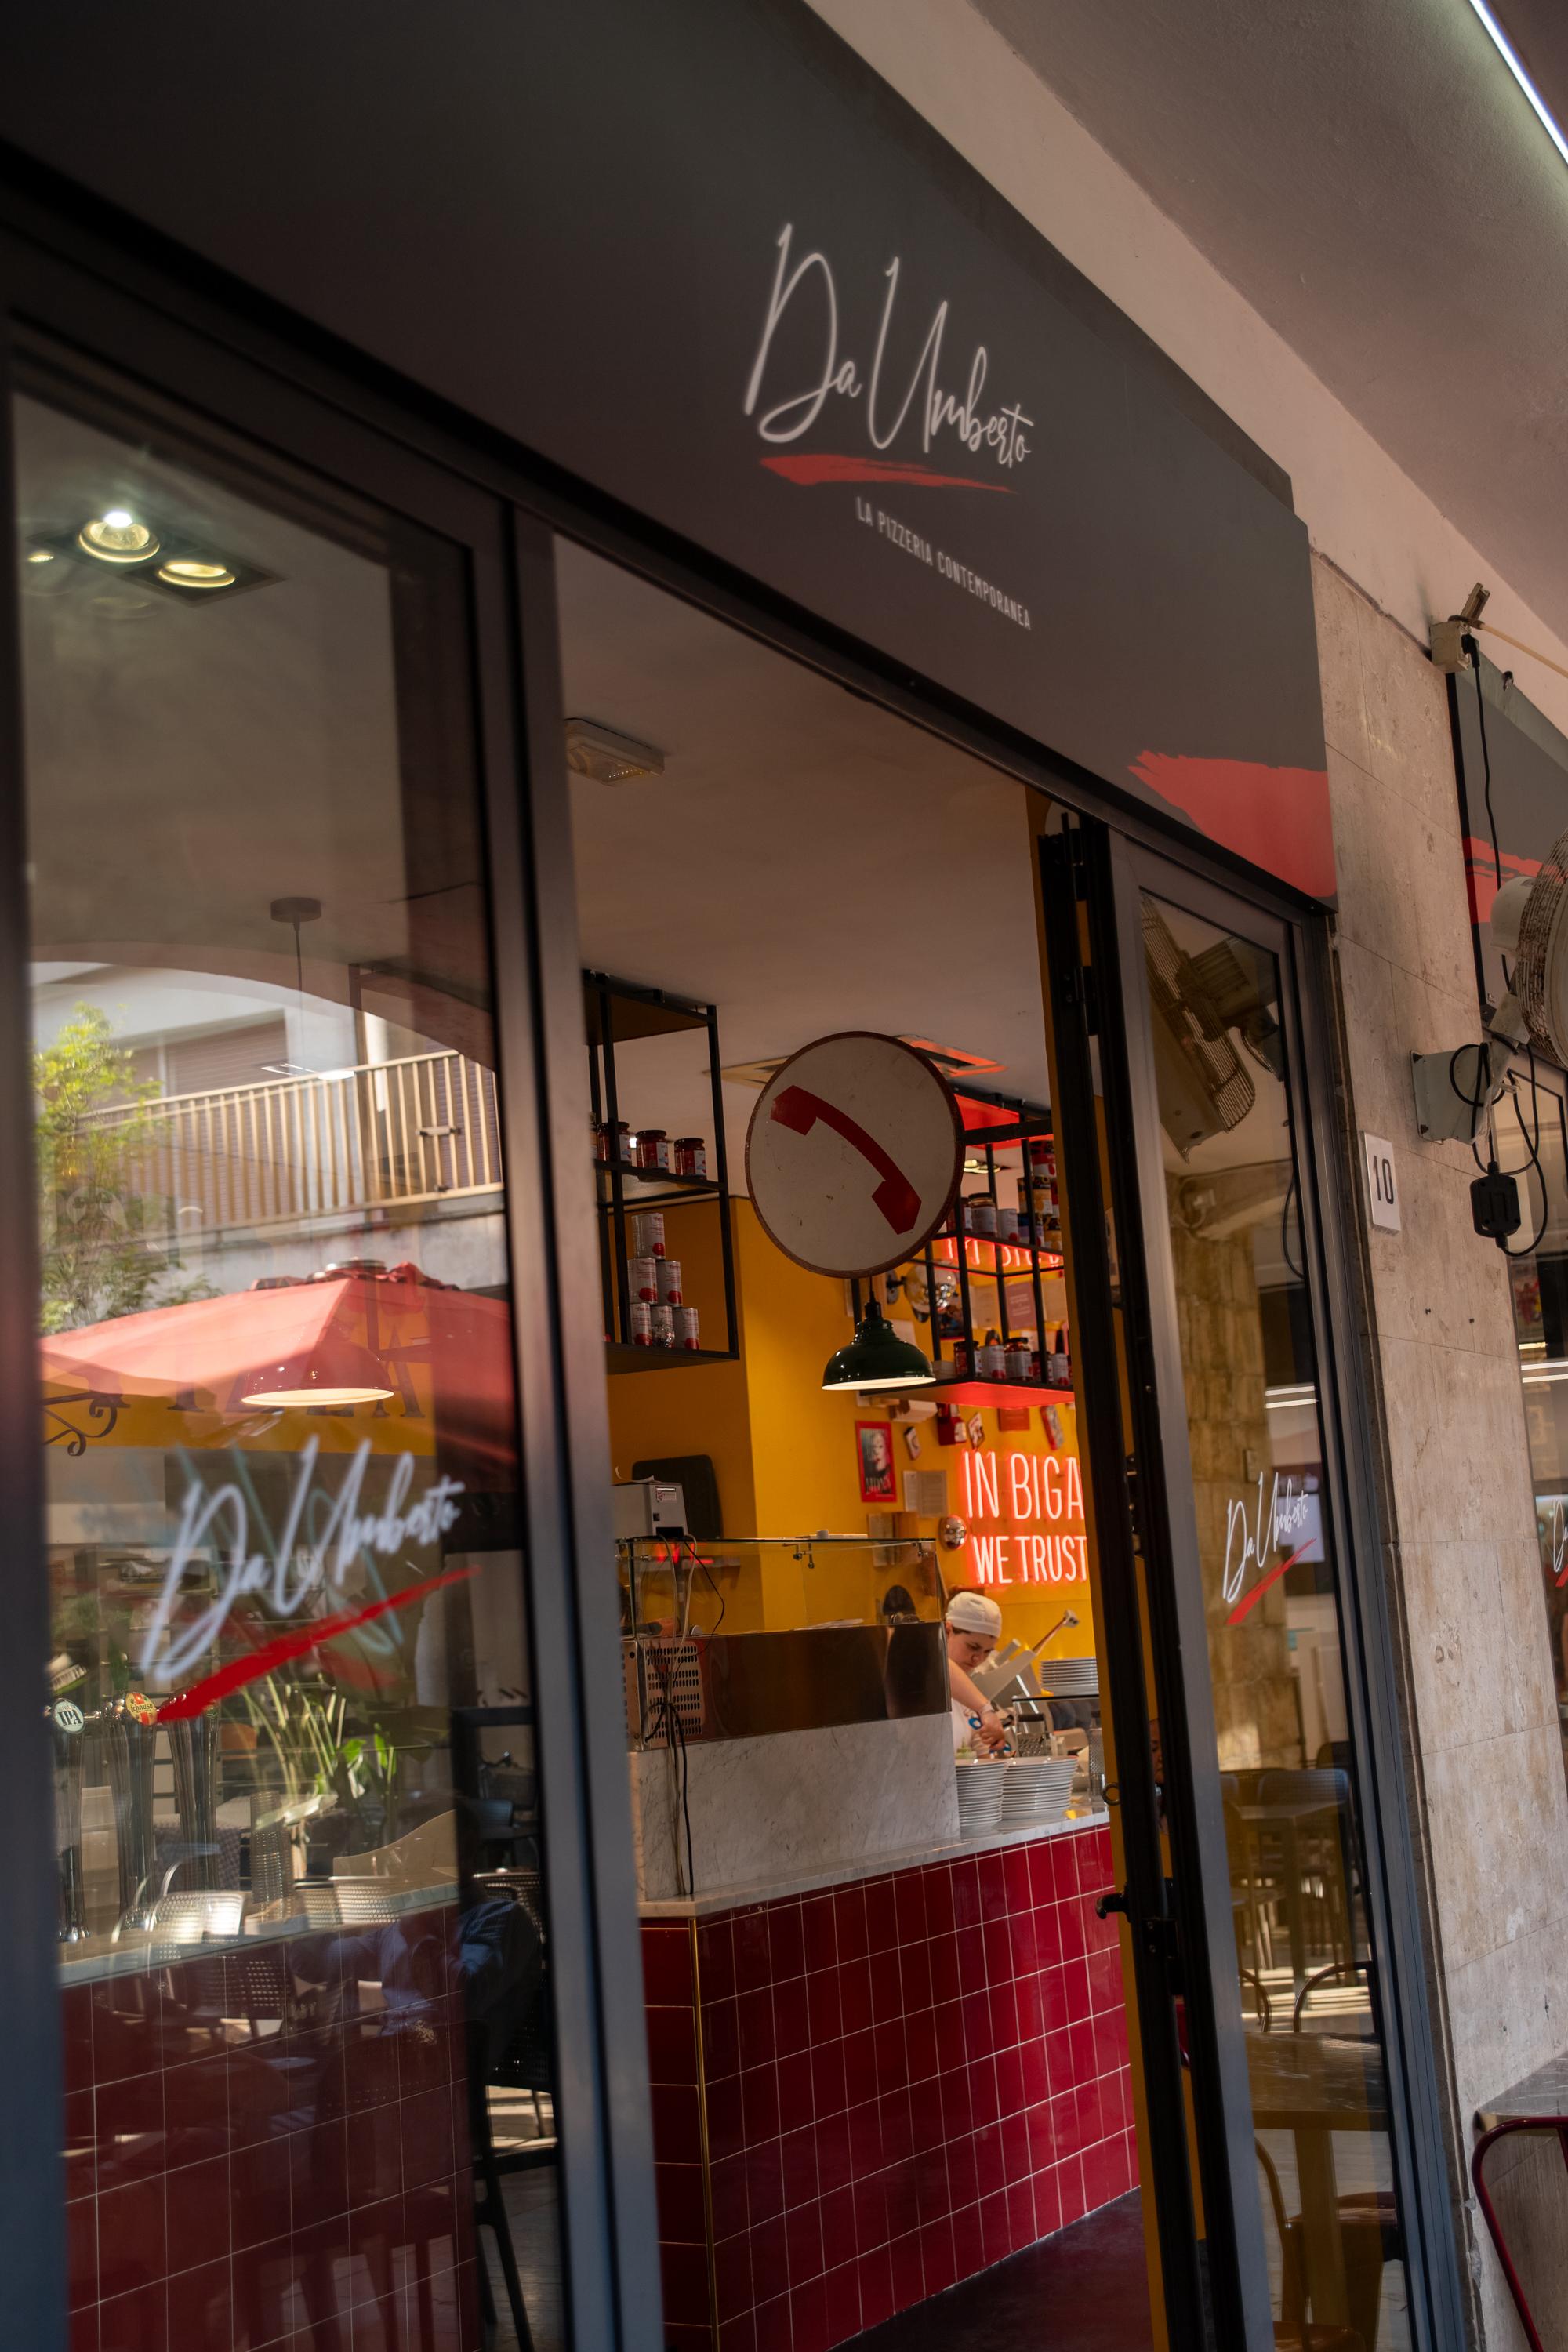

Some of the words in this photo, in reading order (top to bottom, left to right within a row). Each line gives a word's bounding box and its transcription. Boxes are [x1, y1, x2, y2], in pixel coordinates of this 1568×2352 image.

[744, 223, 862, 442] Da
[869, 256, 1034, 468] Umberto
[856, 496, 873, 528] LA
[878, 512, 933, 566] PIZZERIA
[938, 552, 1031, 630] CONTEMPORANEA
[1373, 1156, 1394, 1204] 10
[964, 1452, 1000, 1519] IN
[1011, 1453, 1085, 1519] BIGA
[973, 1535, 1013, 1584] WE
[1014, 1535, 1087, 1582] TRUST
[1223, 1498, 1254, 1603] Da
[1257, 1471, 1308, 1568] Umberto
[57, 1709, 82, 1726] IPA
